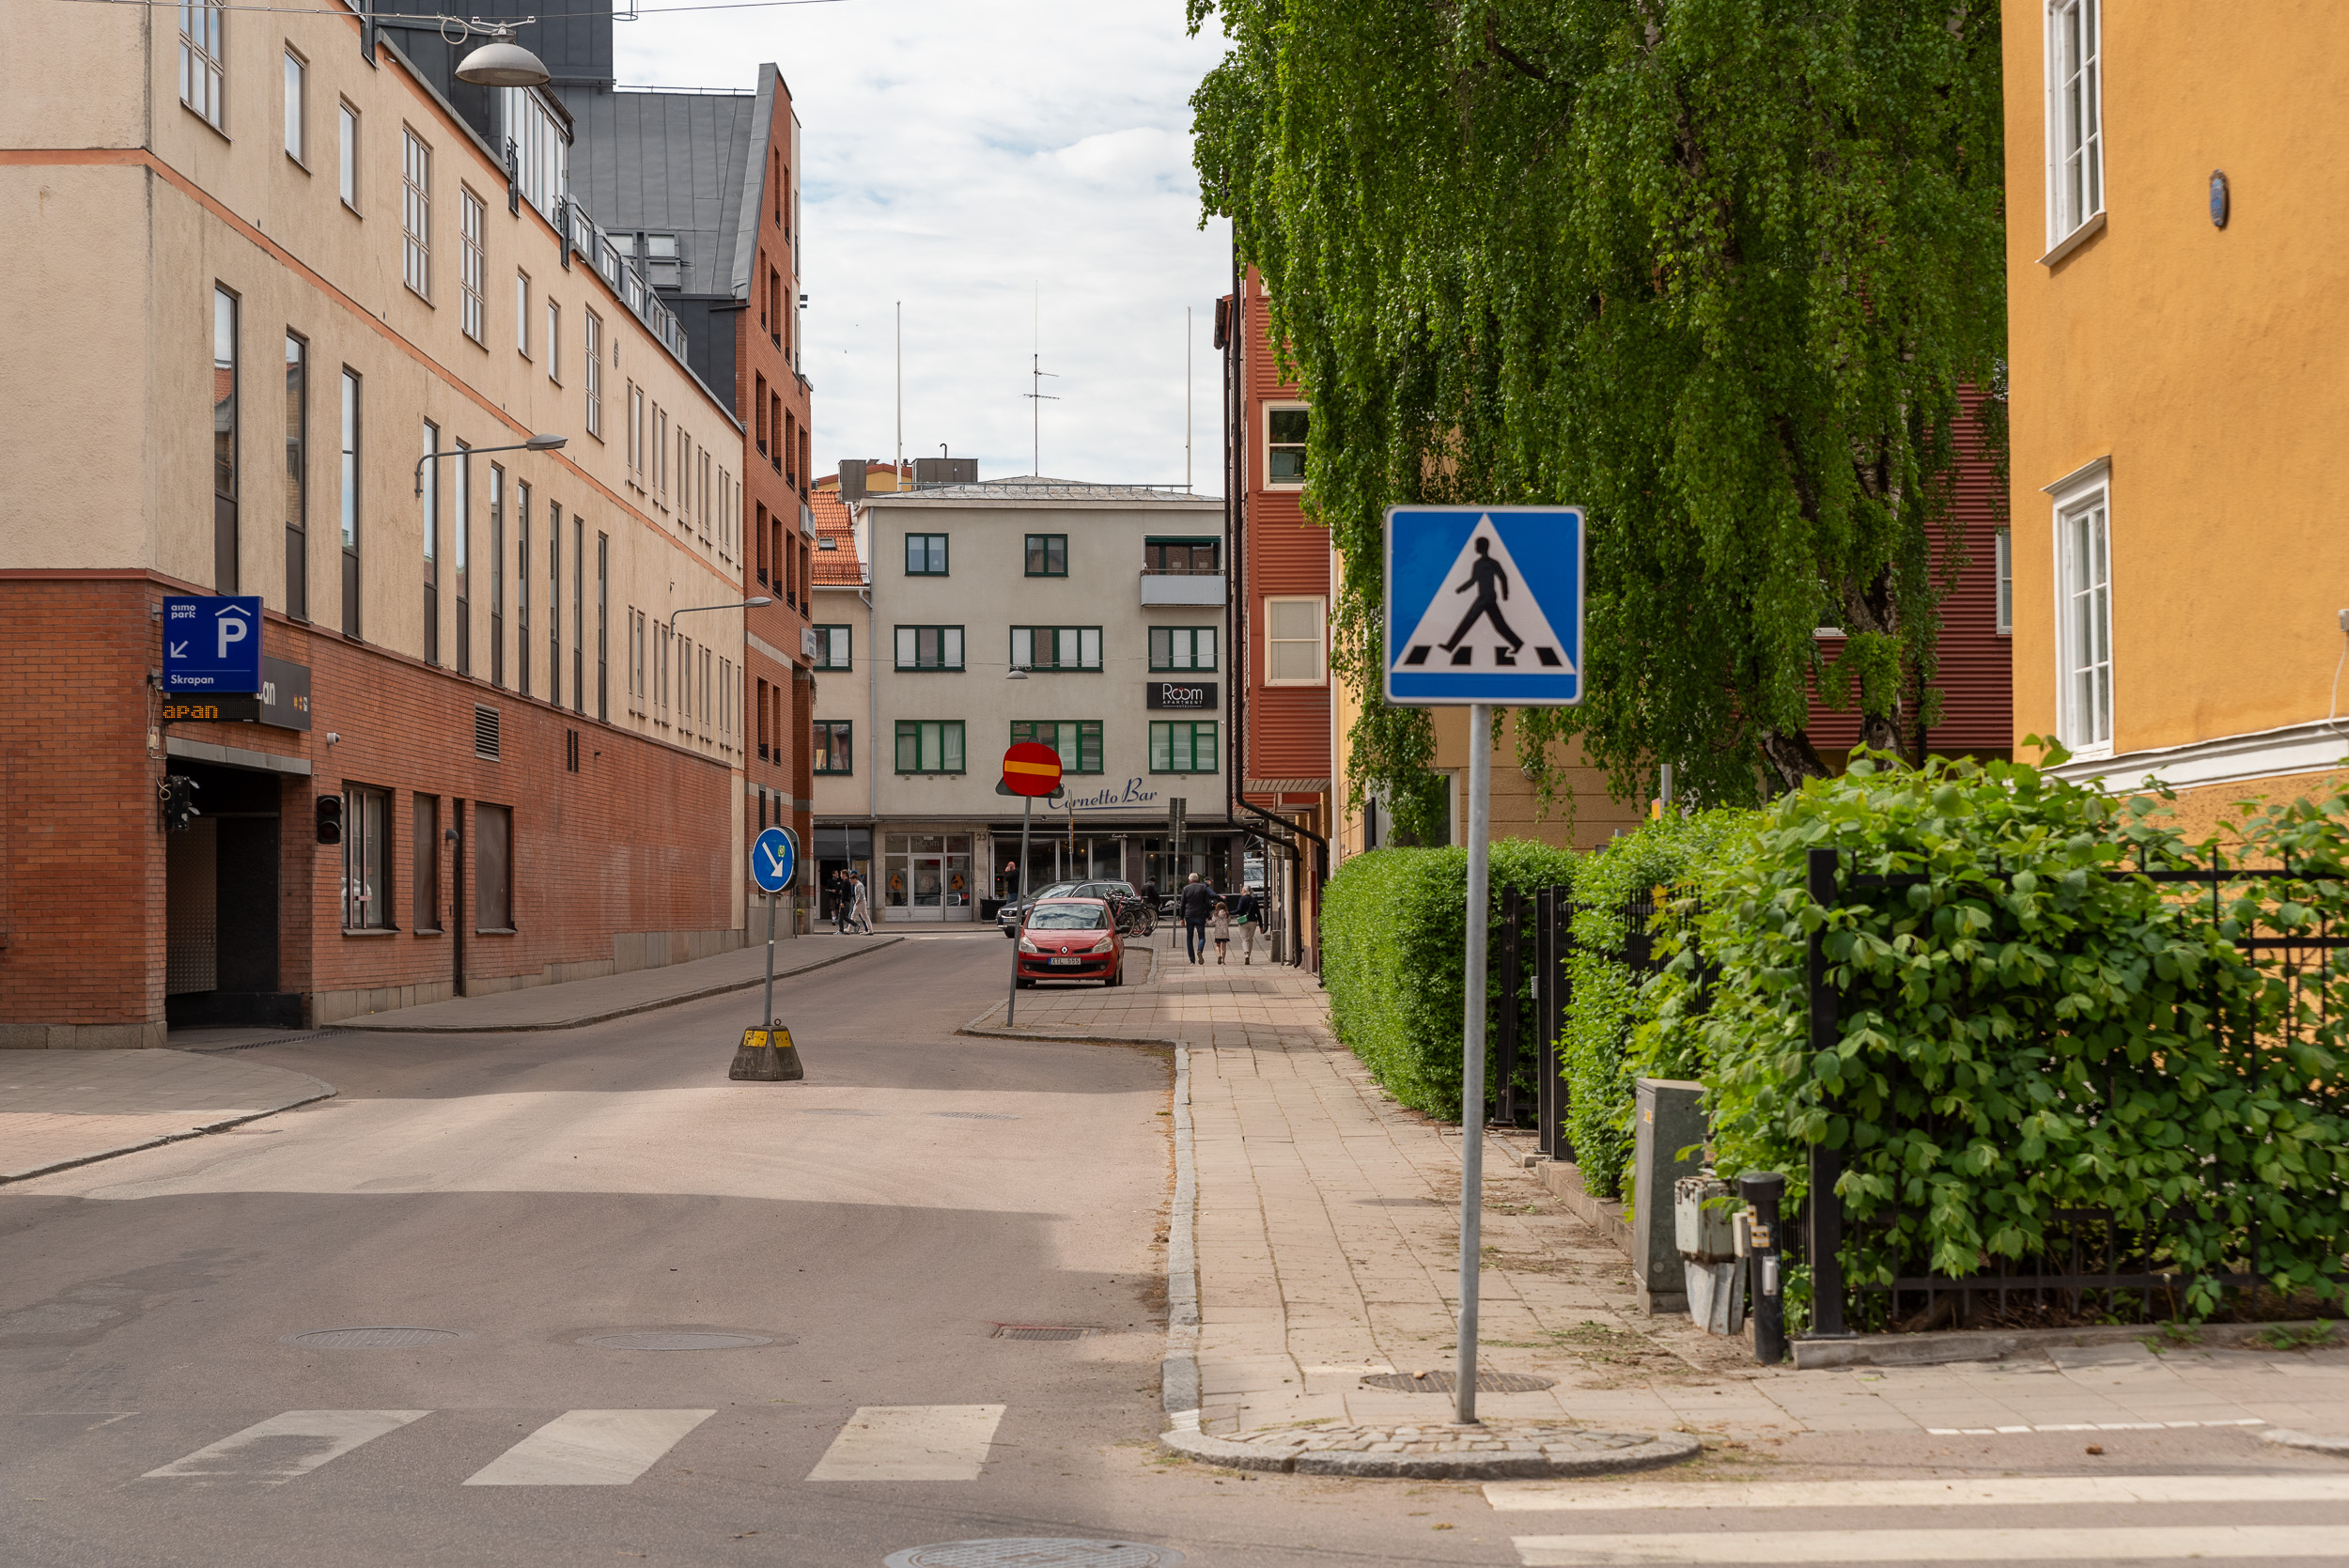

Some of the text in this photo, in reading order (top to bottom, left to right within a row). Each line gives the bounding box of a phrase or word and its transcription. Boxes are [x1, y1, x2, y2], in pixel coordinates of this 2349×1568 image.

[171, 611, 196, 620] park
[218, 617, 248, 659] P
[170, 675, 214, 687] Skrapan
[1162, 683, 1203, 701] Room
[1122, 777, 1158, 803] Bar
[976, 832, 988, 842] 23
